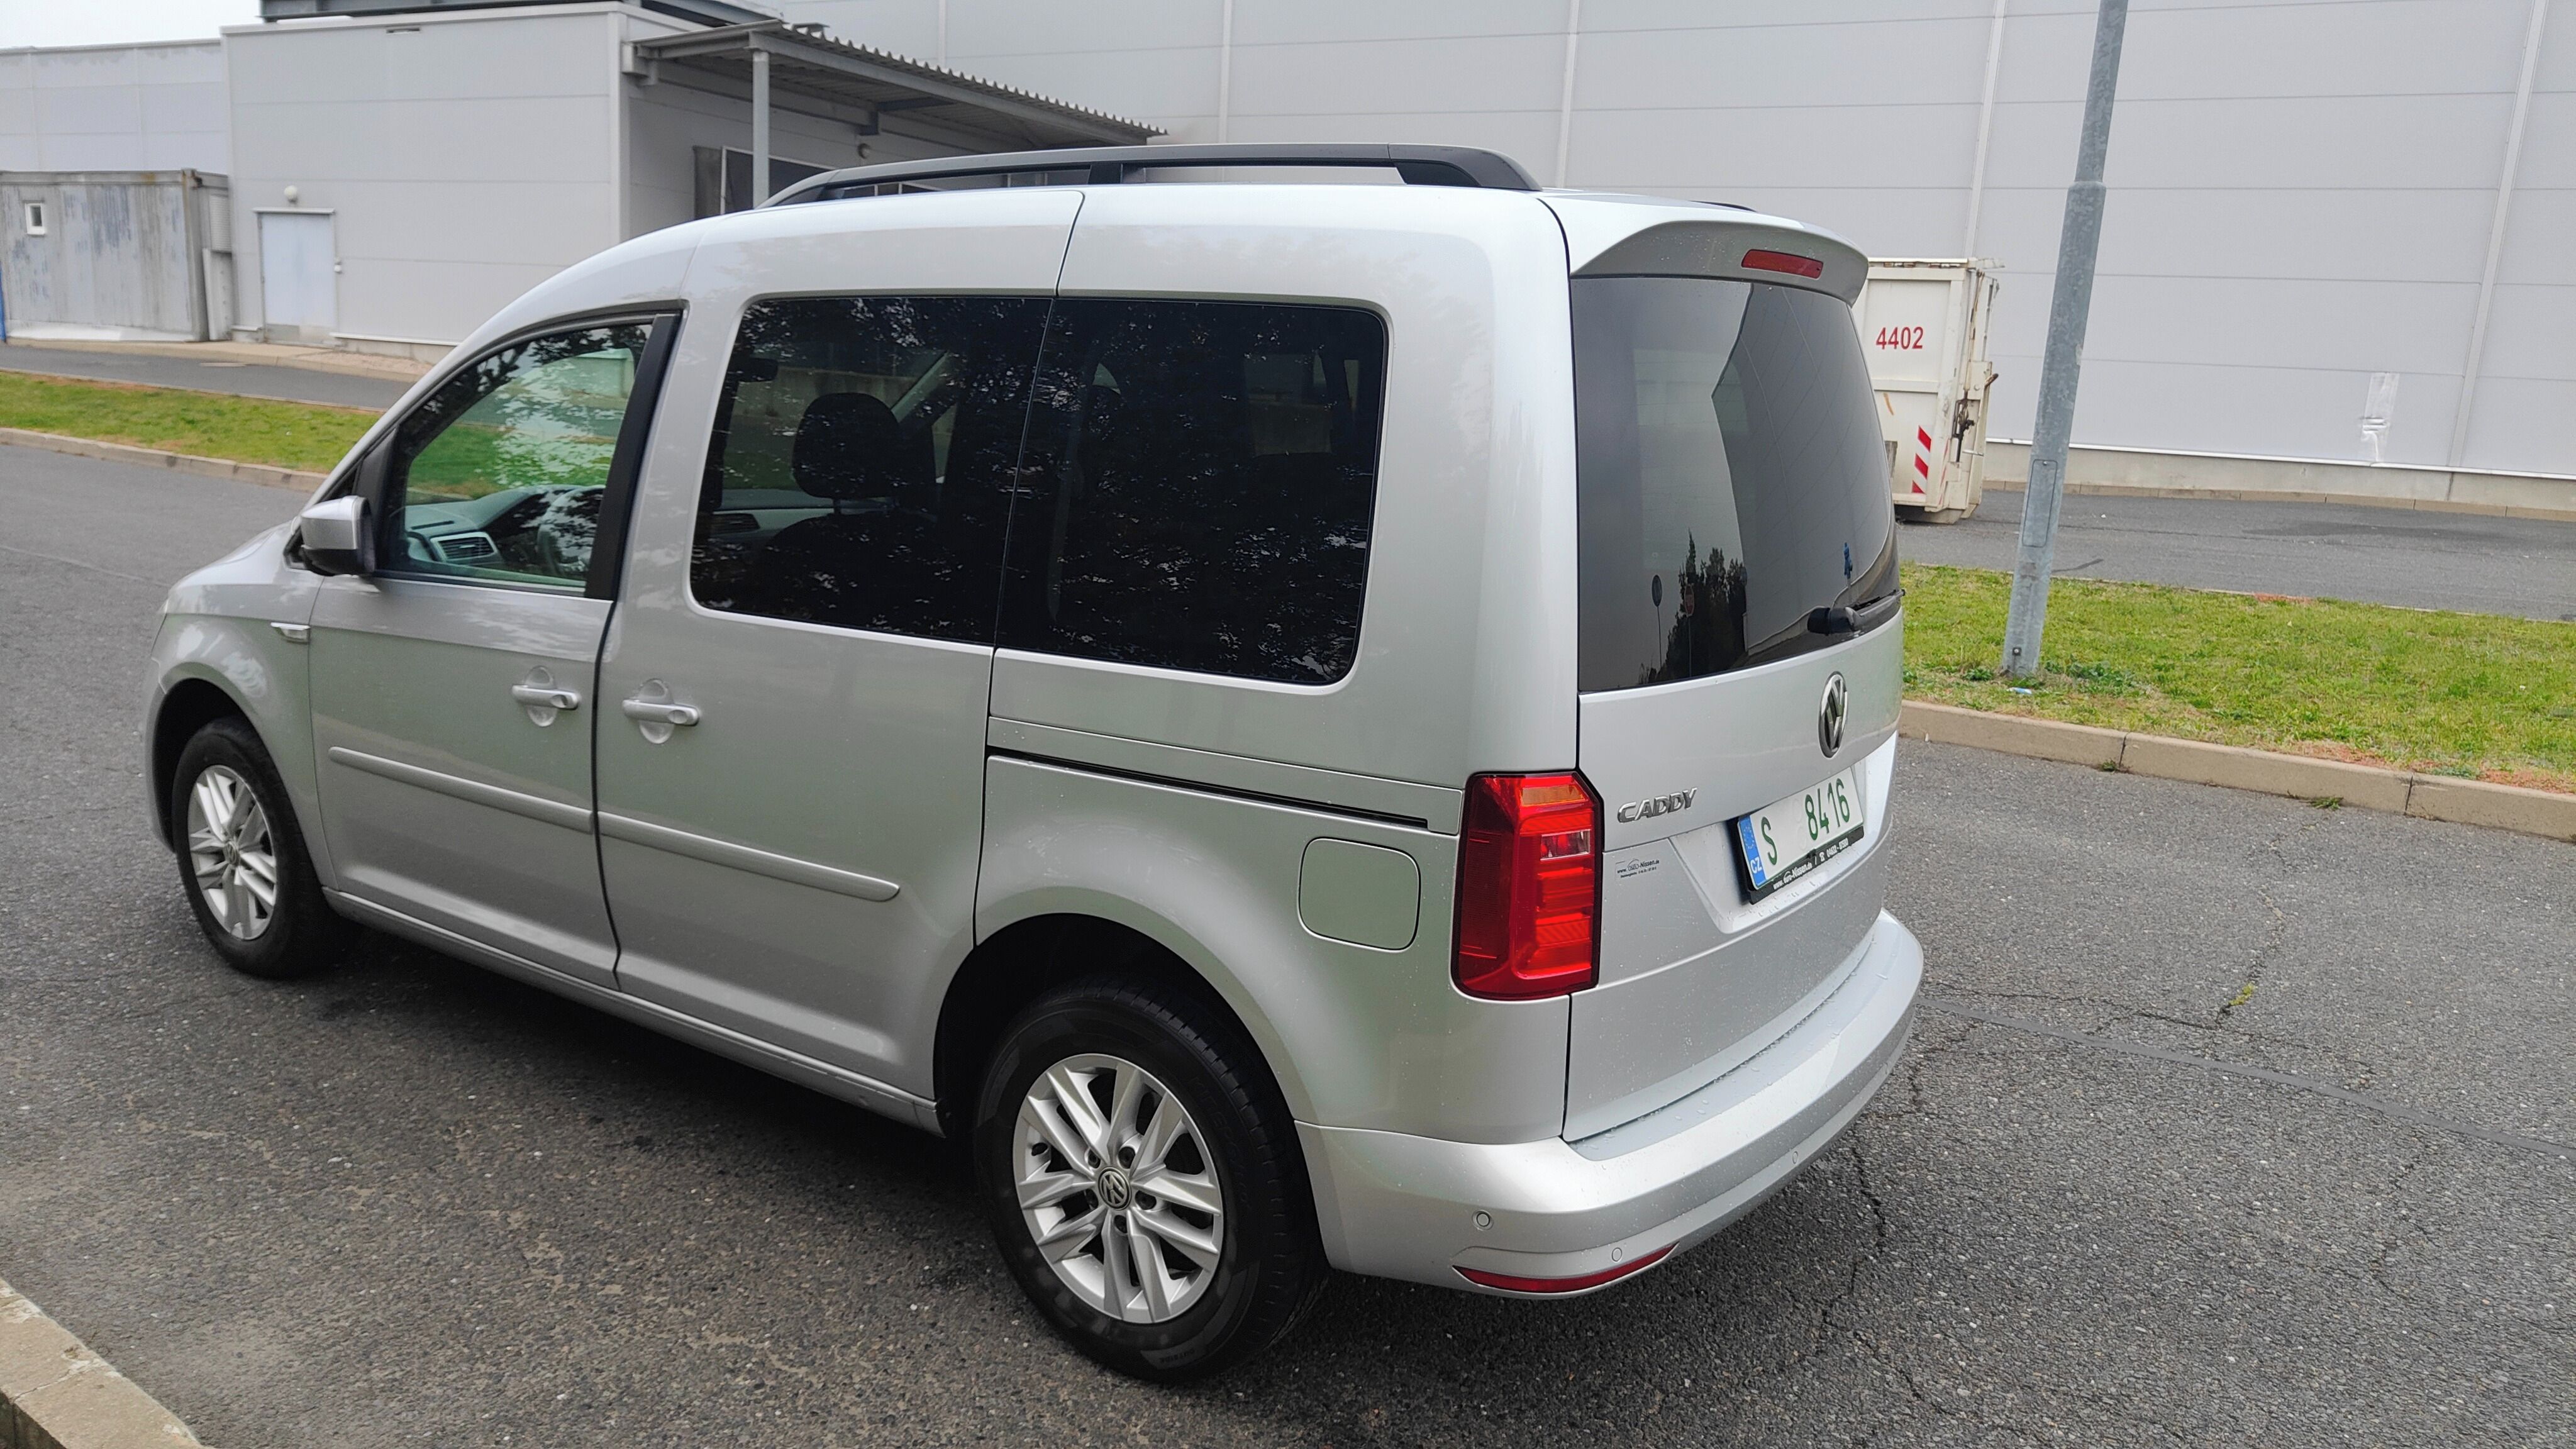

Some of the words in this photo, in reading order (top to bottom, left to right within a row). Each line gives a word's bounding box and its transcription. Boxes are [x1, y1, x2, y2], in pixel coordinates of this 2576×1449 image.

[1875, 326, 1924, 350] 4402
[1617, 787, 1697, 823] CADDY
[1804, 777, 1850, 840] 8416
[1750, 857, 1762, 874] CZ
